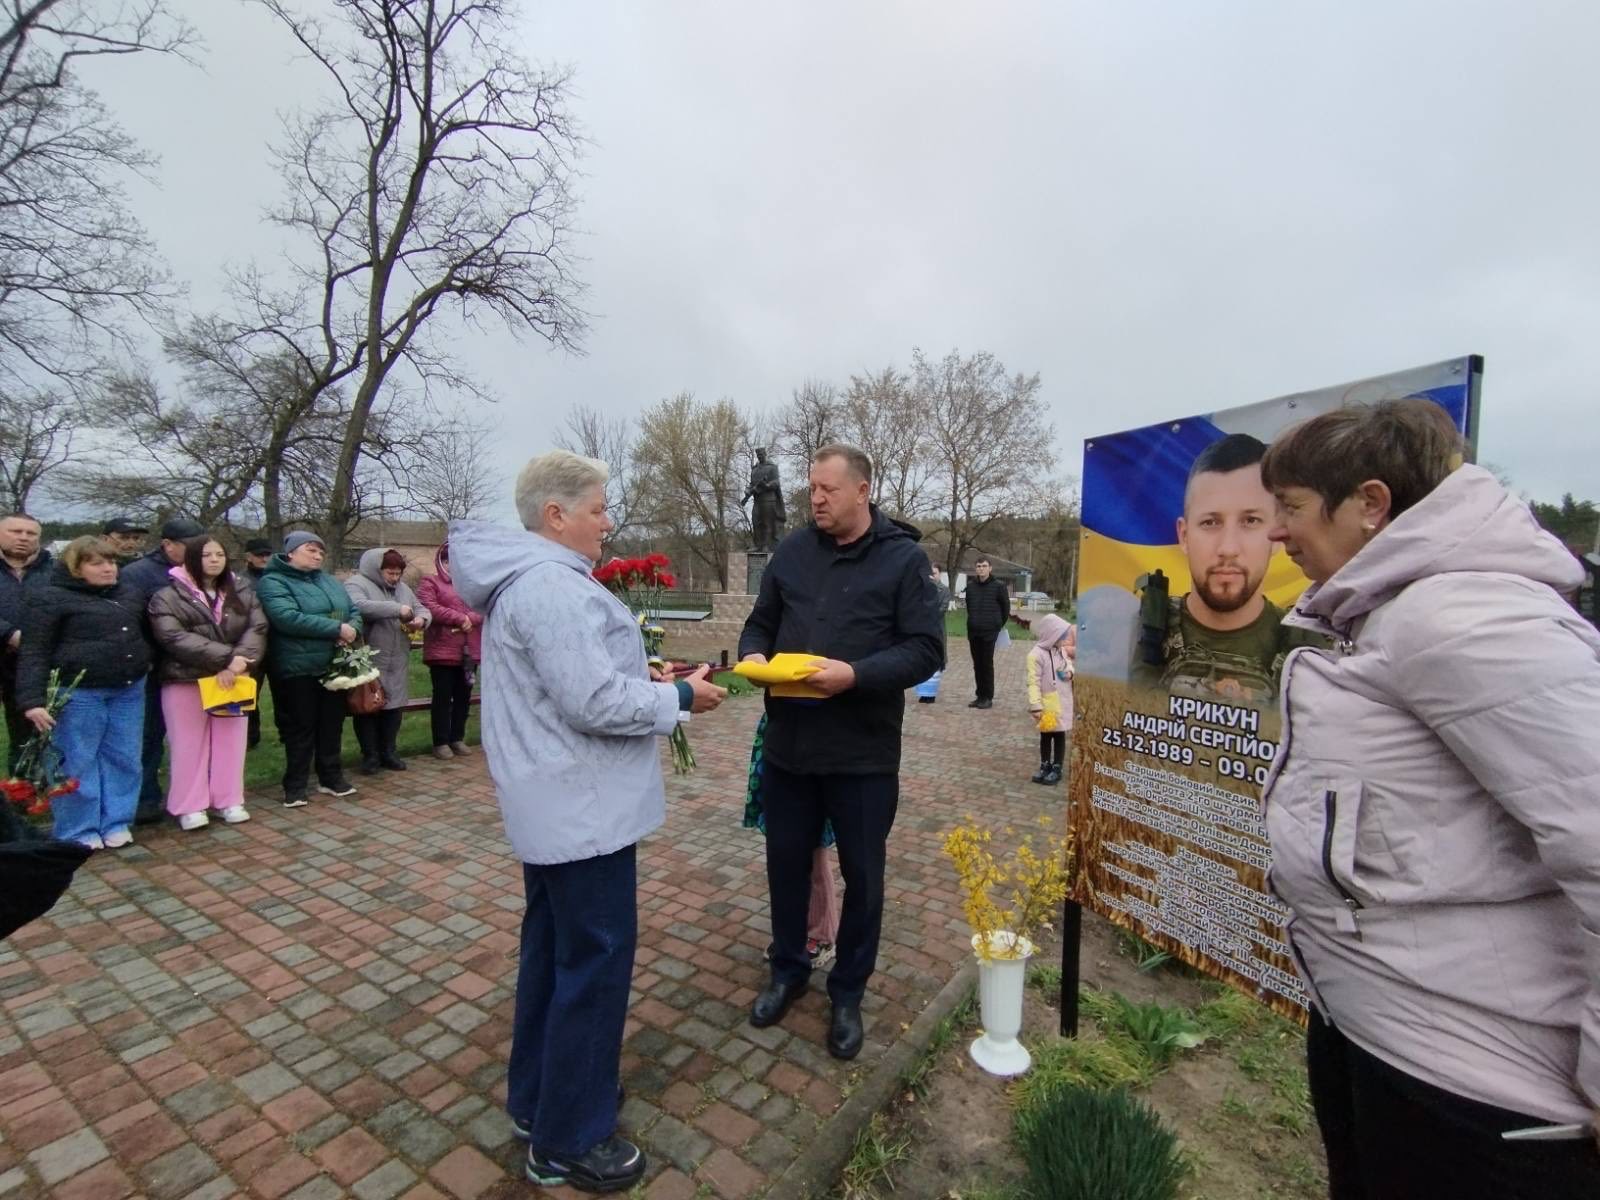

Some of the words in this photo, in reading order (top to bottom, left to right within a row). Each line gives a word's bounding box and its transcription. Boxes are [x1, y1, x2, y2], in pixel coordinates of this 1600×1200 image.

[1169, 696, 1258, 731] КРИКУН
[1102, 728, 1193, 766] 25.12.1989
[1123, 712, 1186, 740] АНДРІЙ
[1190, 726, 1280, 761] СЕРГІЙО
[1162, 784, 1184, 800] рота
[1187, 790, 1210, 806] 2-го
[1168, 772, 1212, 793] бойовий
[1215, 787, 1257, 809] медик,
[1129, 800, 1139, 809] на
[1141, 803, 1187, 827] околицях
[1191, 819, 1236, 845] Орлівки
[1188, 803, 1253, 834] Штурмової
[1178, 847, 1235, 879] Нагороди:
[1192, 833, 1247, 863] керована
[1190, 863, 1253, 898] збережене
[1209, 947, 1257, 982] ступеня
[1250, 955, 1303, 991] ступеня
